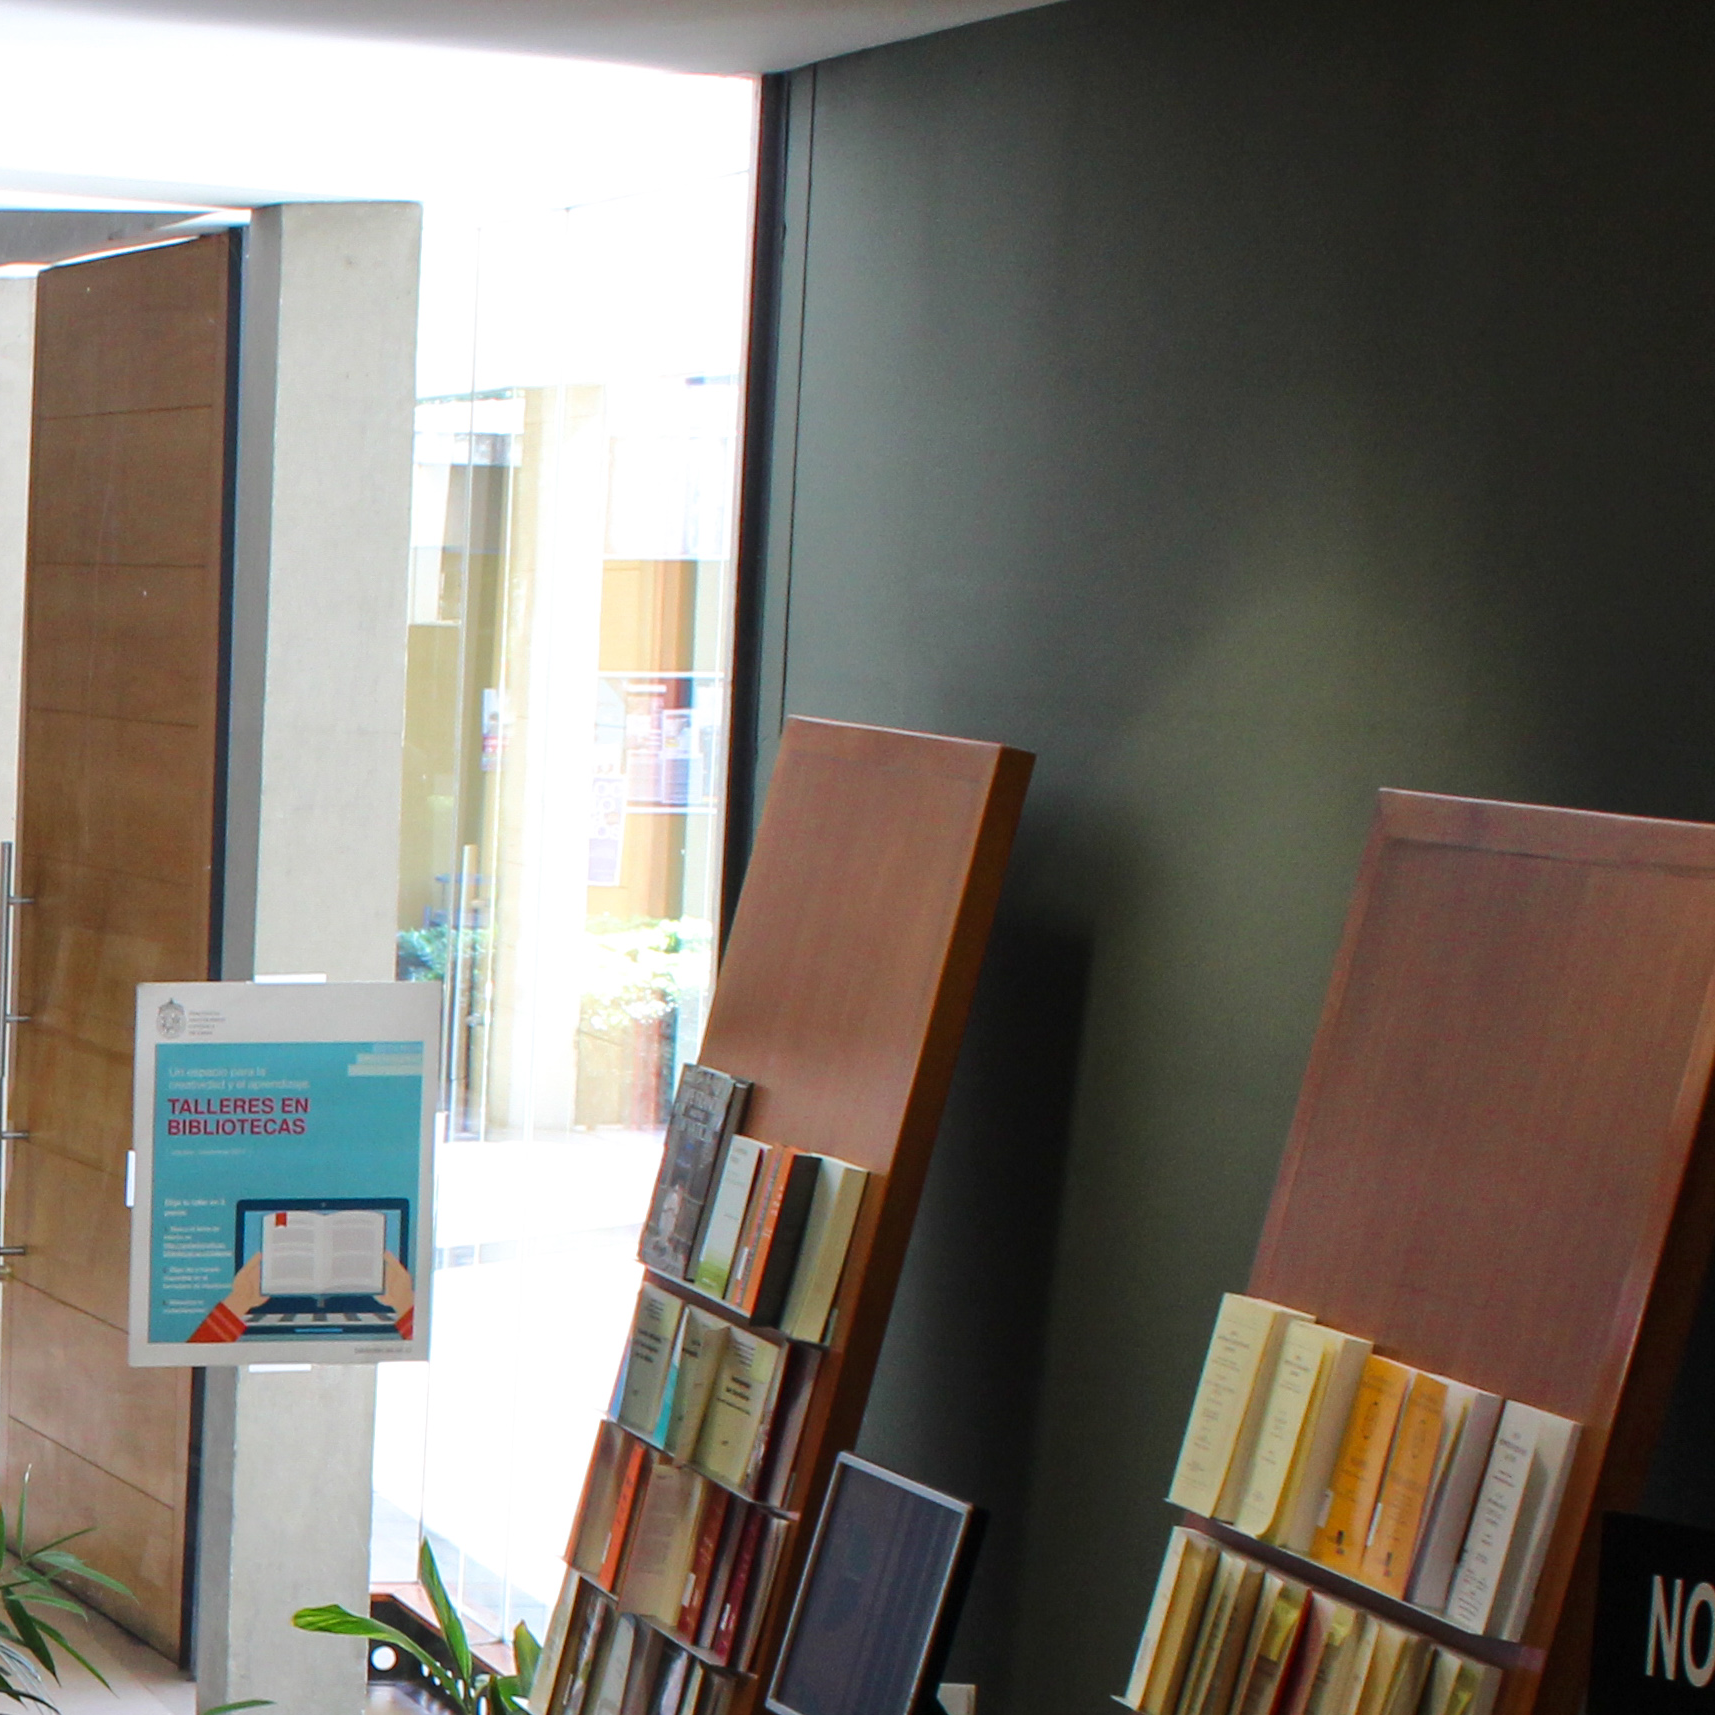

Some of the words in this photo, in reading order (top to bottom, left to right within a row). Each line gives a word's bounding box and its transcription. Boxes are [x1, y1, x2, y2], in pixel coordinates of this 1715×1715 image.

[167, 1097, 275, 1115] TALLERES
[281, 1097, 310, 1115] EN
[167, 1118, 306, 1136] BIBLIOTECAS
[1644, 1573, 1715, 1688] NO
